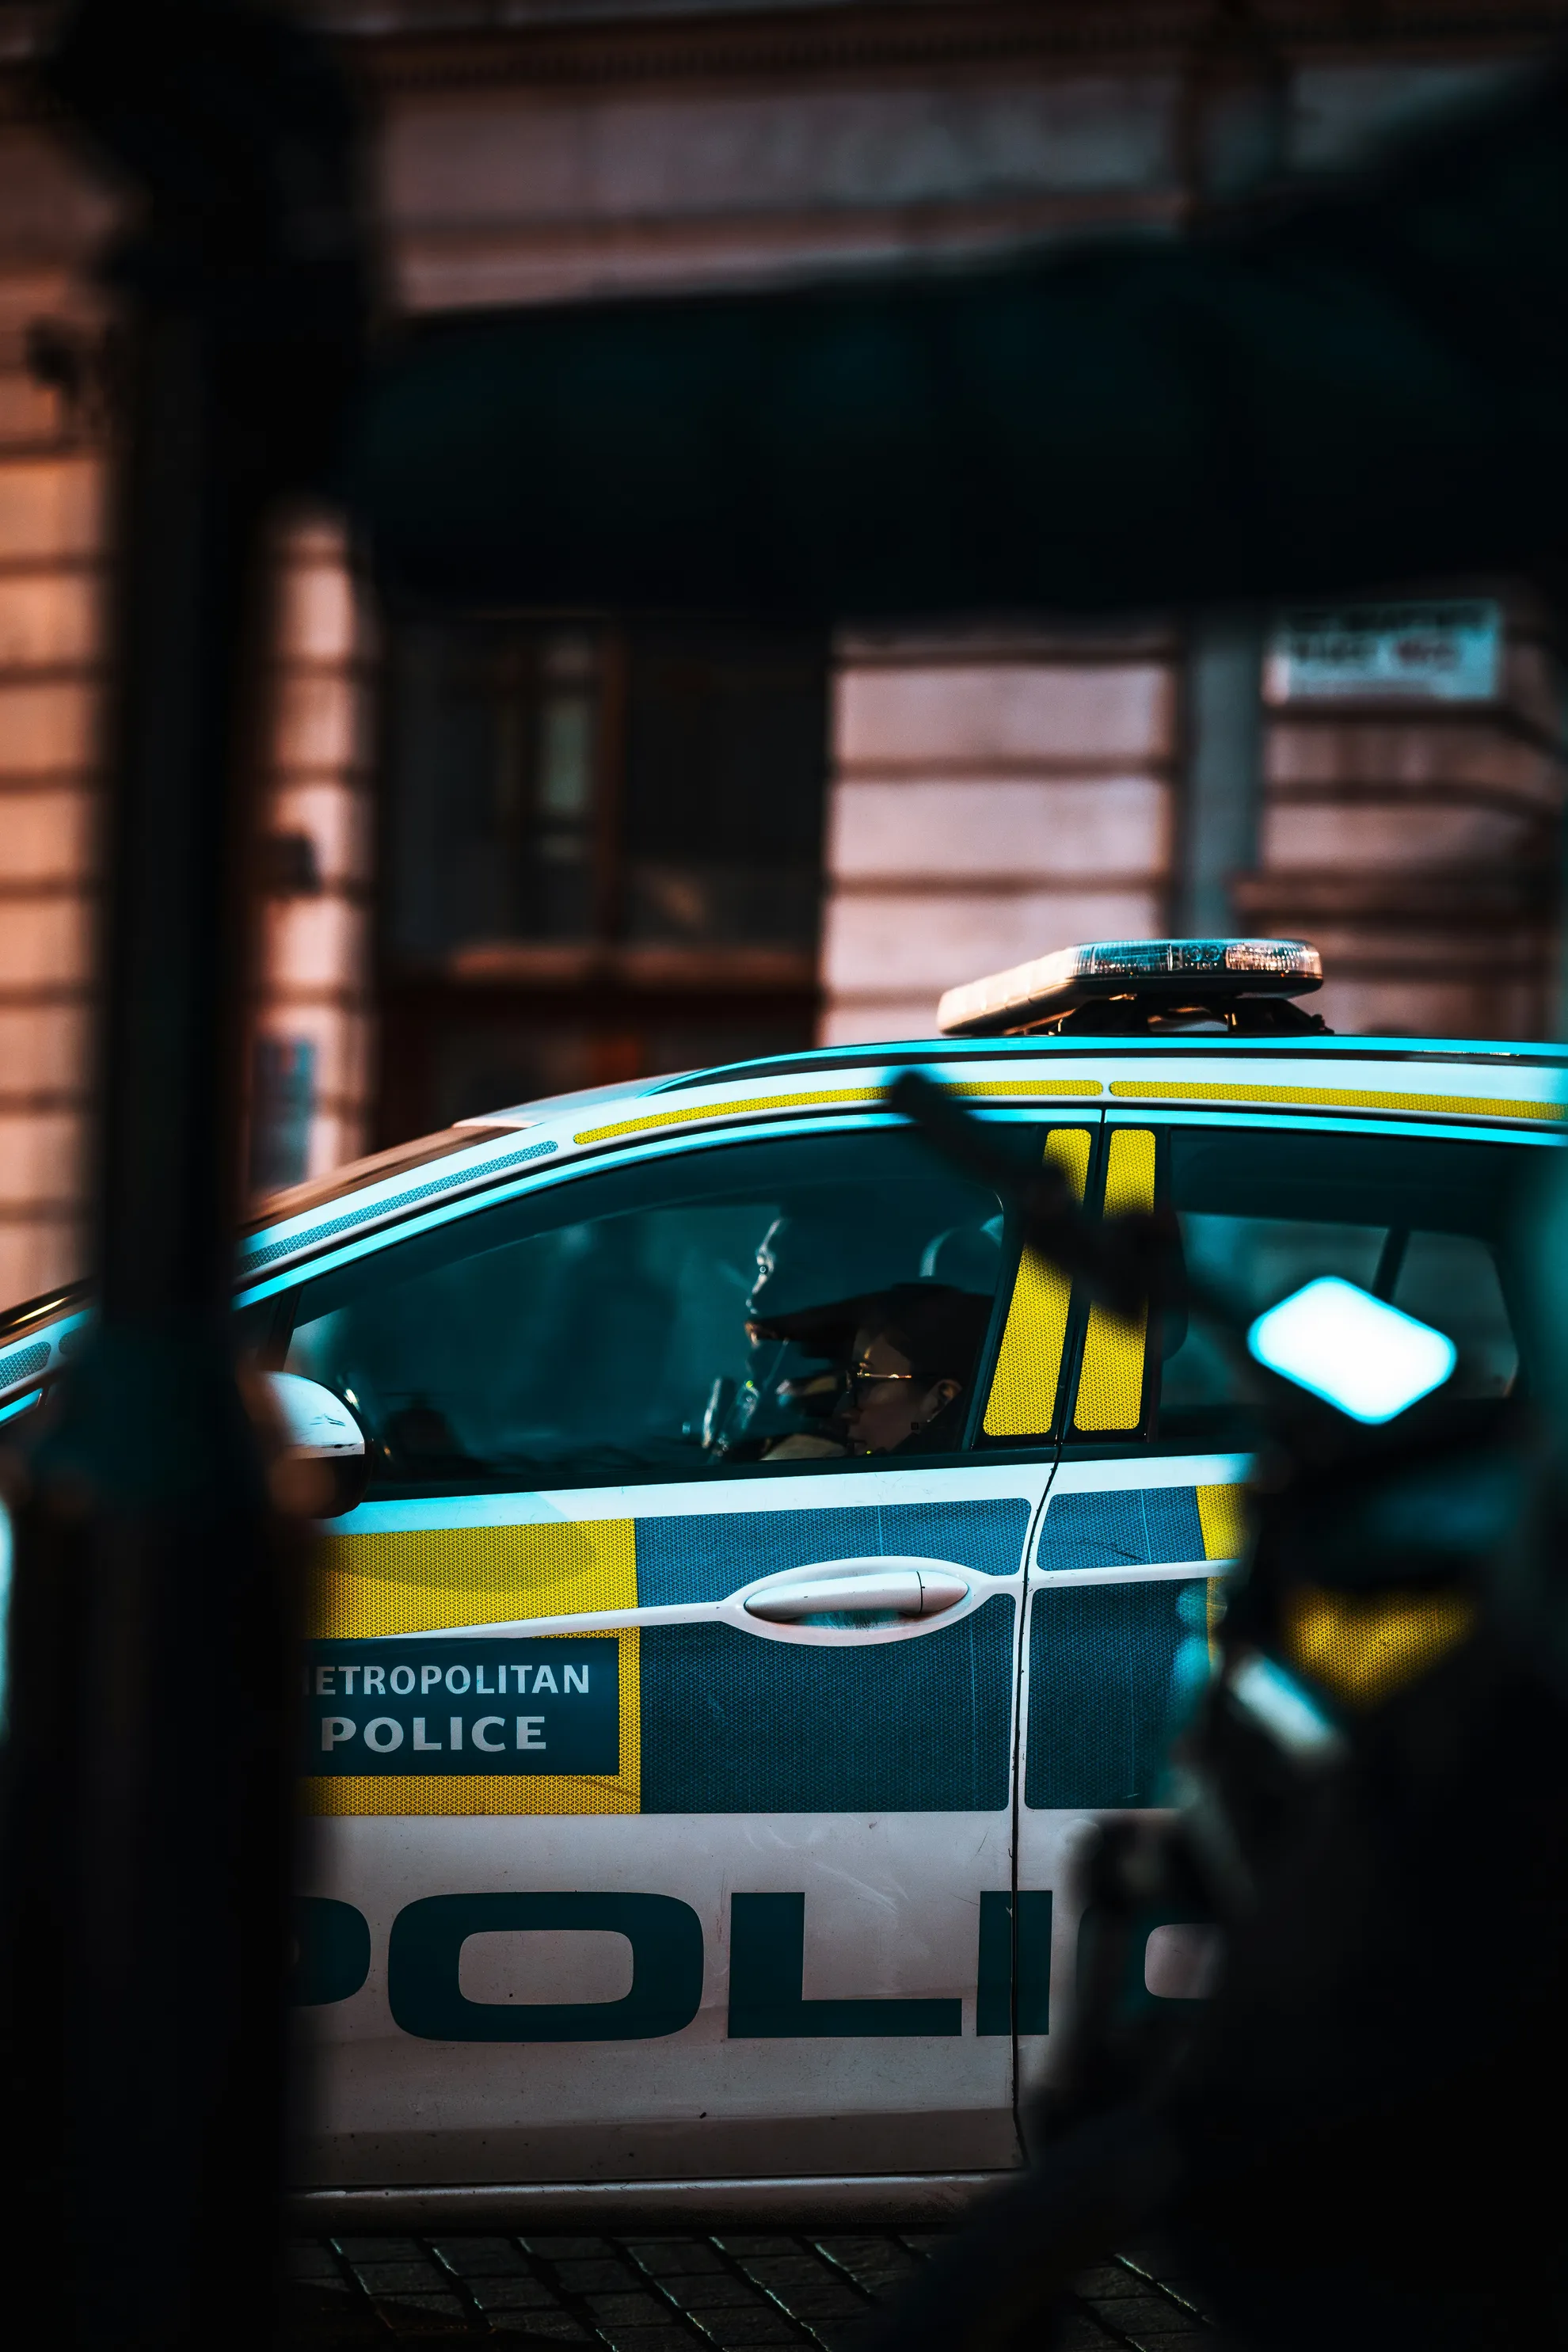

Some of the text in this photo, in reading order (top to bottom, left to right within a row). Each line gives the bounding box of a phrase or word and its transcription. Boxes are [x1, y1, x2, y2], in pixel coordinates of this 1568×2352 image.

[301, 1665, 589, 1695] ETROPOLITAN
[321, 1715, 546, 1753] POLICE
[287, 1890, 1231, 2042] OLI
